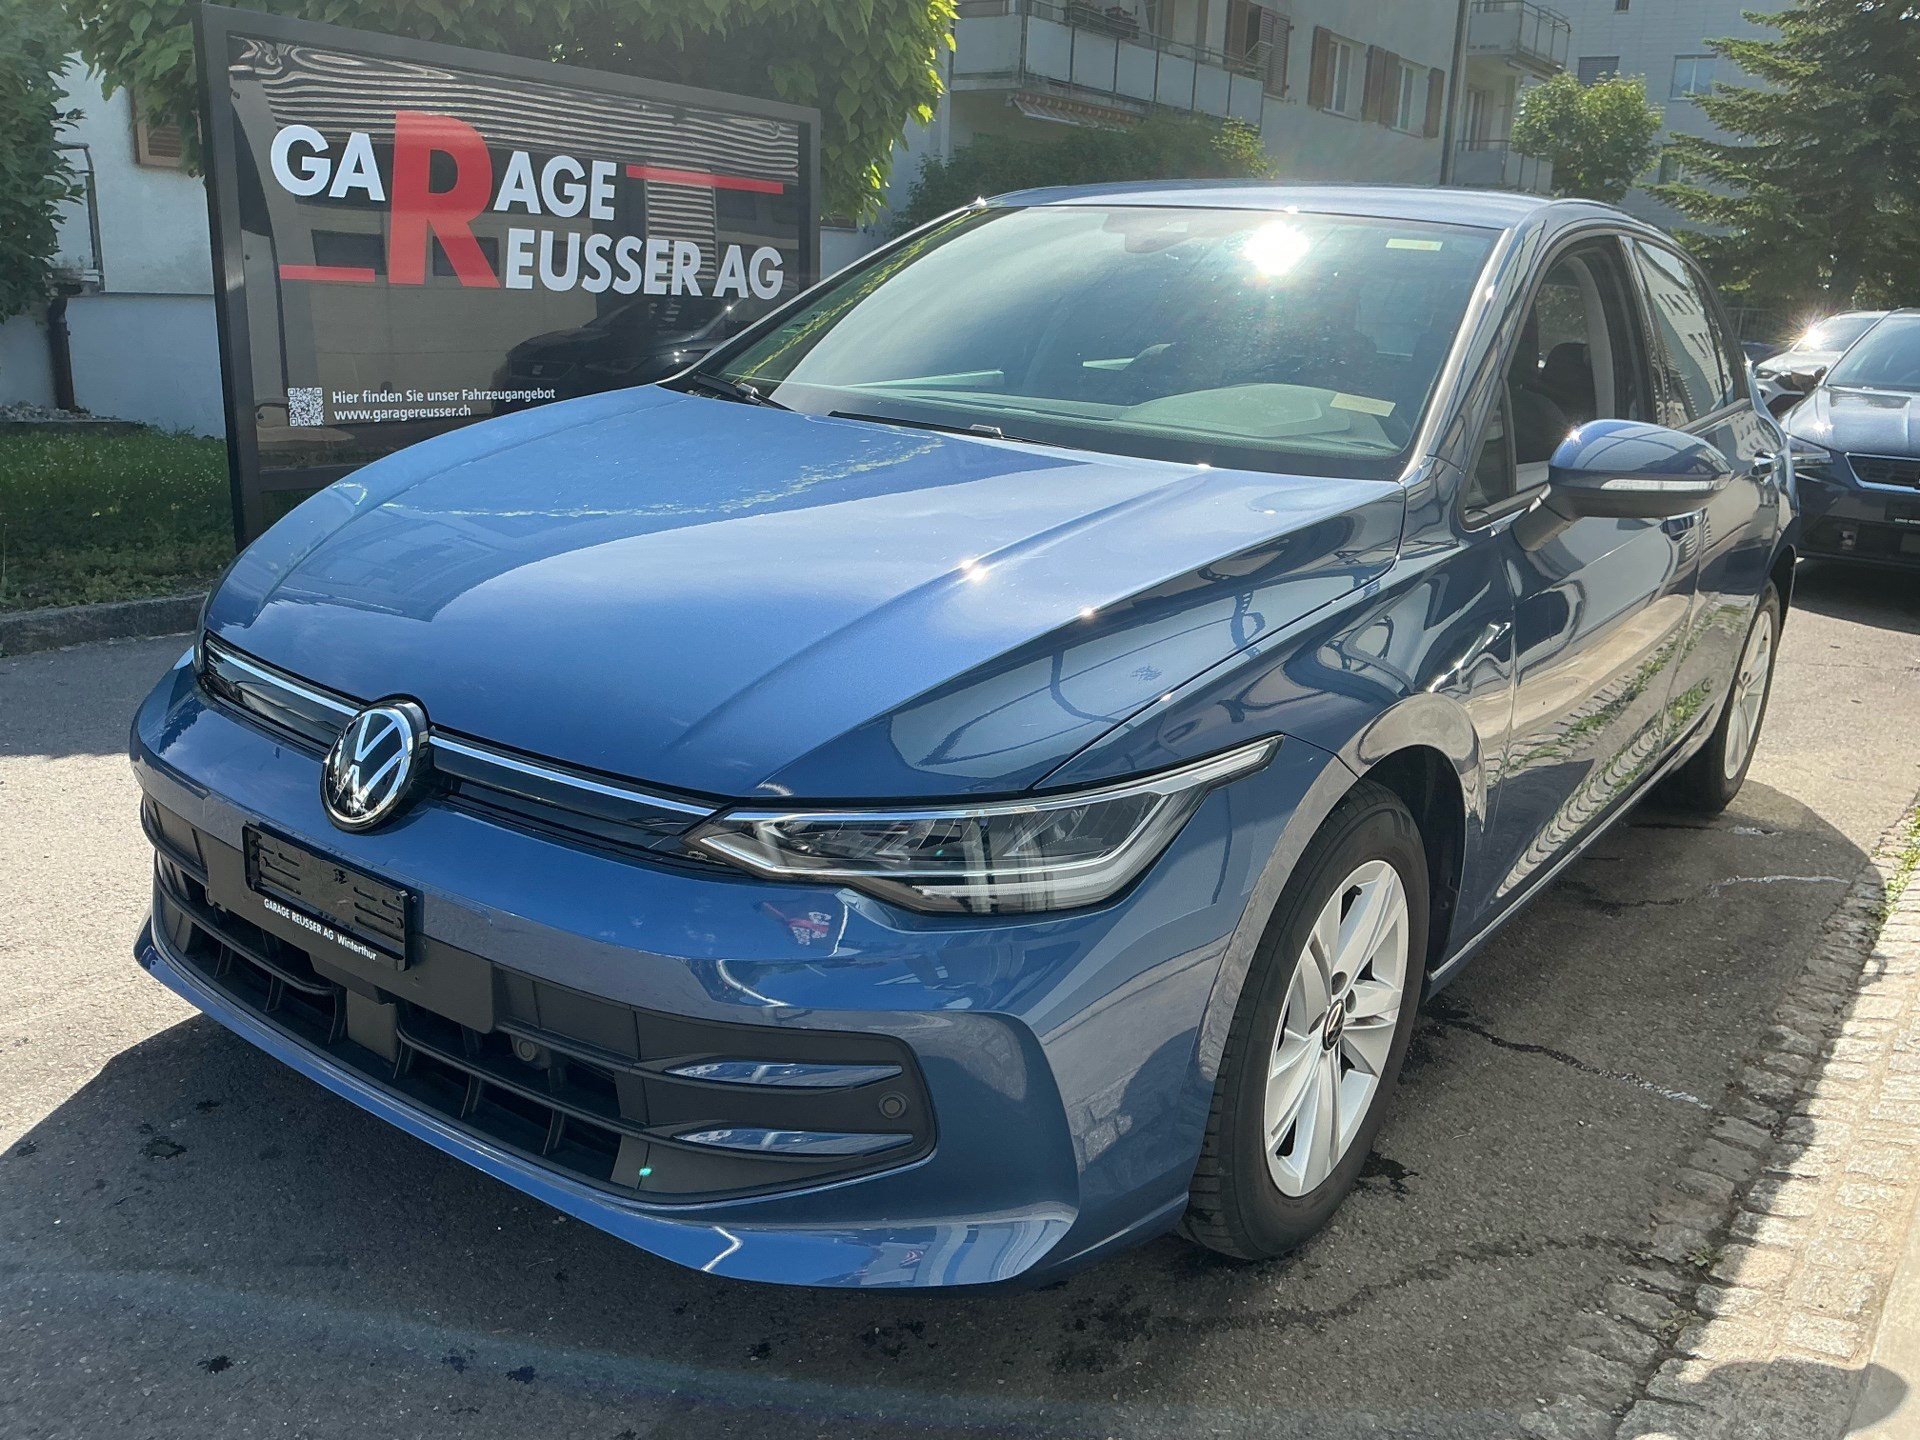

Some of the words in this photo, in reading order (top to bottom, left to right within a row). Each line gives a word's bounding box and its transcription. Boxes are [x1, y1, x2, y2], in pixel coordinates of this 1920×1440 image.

[270, 109, 618, 288] GARAGE
[712, 244, 784, 300] AG
[332, 390, 360, 404] Hier
[362, 389, 403, 403] finden
[406, 389, 424, 402] Sie
[427, 390, 460, 401] unser
[462, 388, 556, 403] Fahrzeugangebot
[334, 404, 472, 422] www.garagereusser.ch
[263, 898, 291, 919] GARAGE
[291, 911, 322, 935] REUSSER
[322, 927, 335, 941] AG
[337, 933, 378, 961] Winterthur
